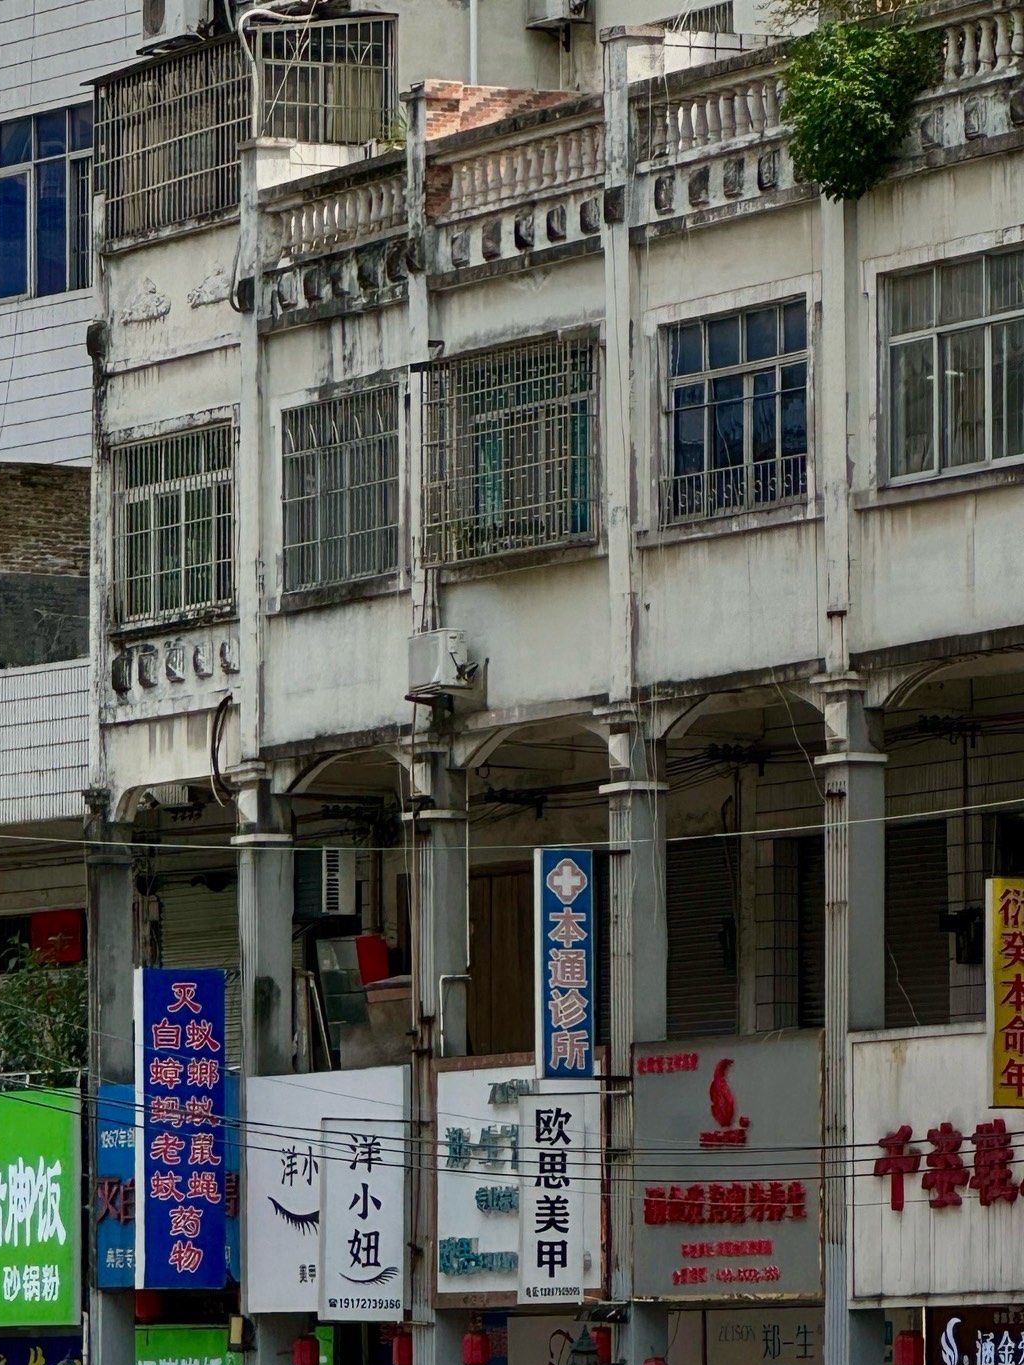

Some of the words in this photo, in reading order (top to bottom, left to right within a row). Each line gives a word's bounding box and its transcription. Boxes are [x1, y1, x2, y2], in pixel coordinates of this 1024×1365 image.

[548, 907, 589, 1071] 本通诊所
[347, 1133, 383, 1270] 洋小妞
[534, 1107, 572, 1278] 欧思美甲
